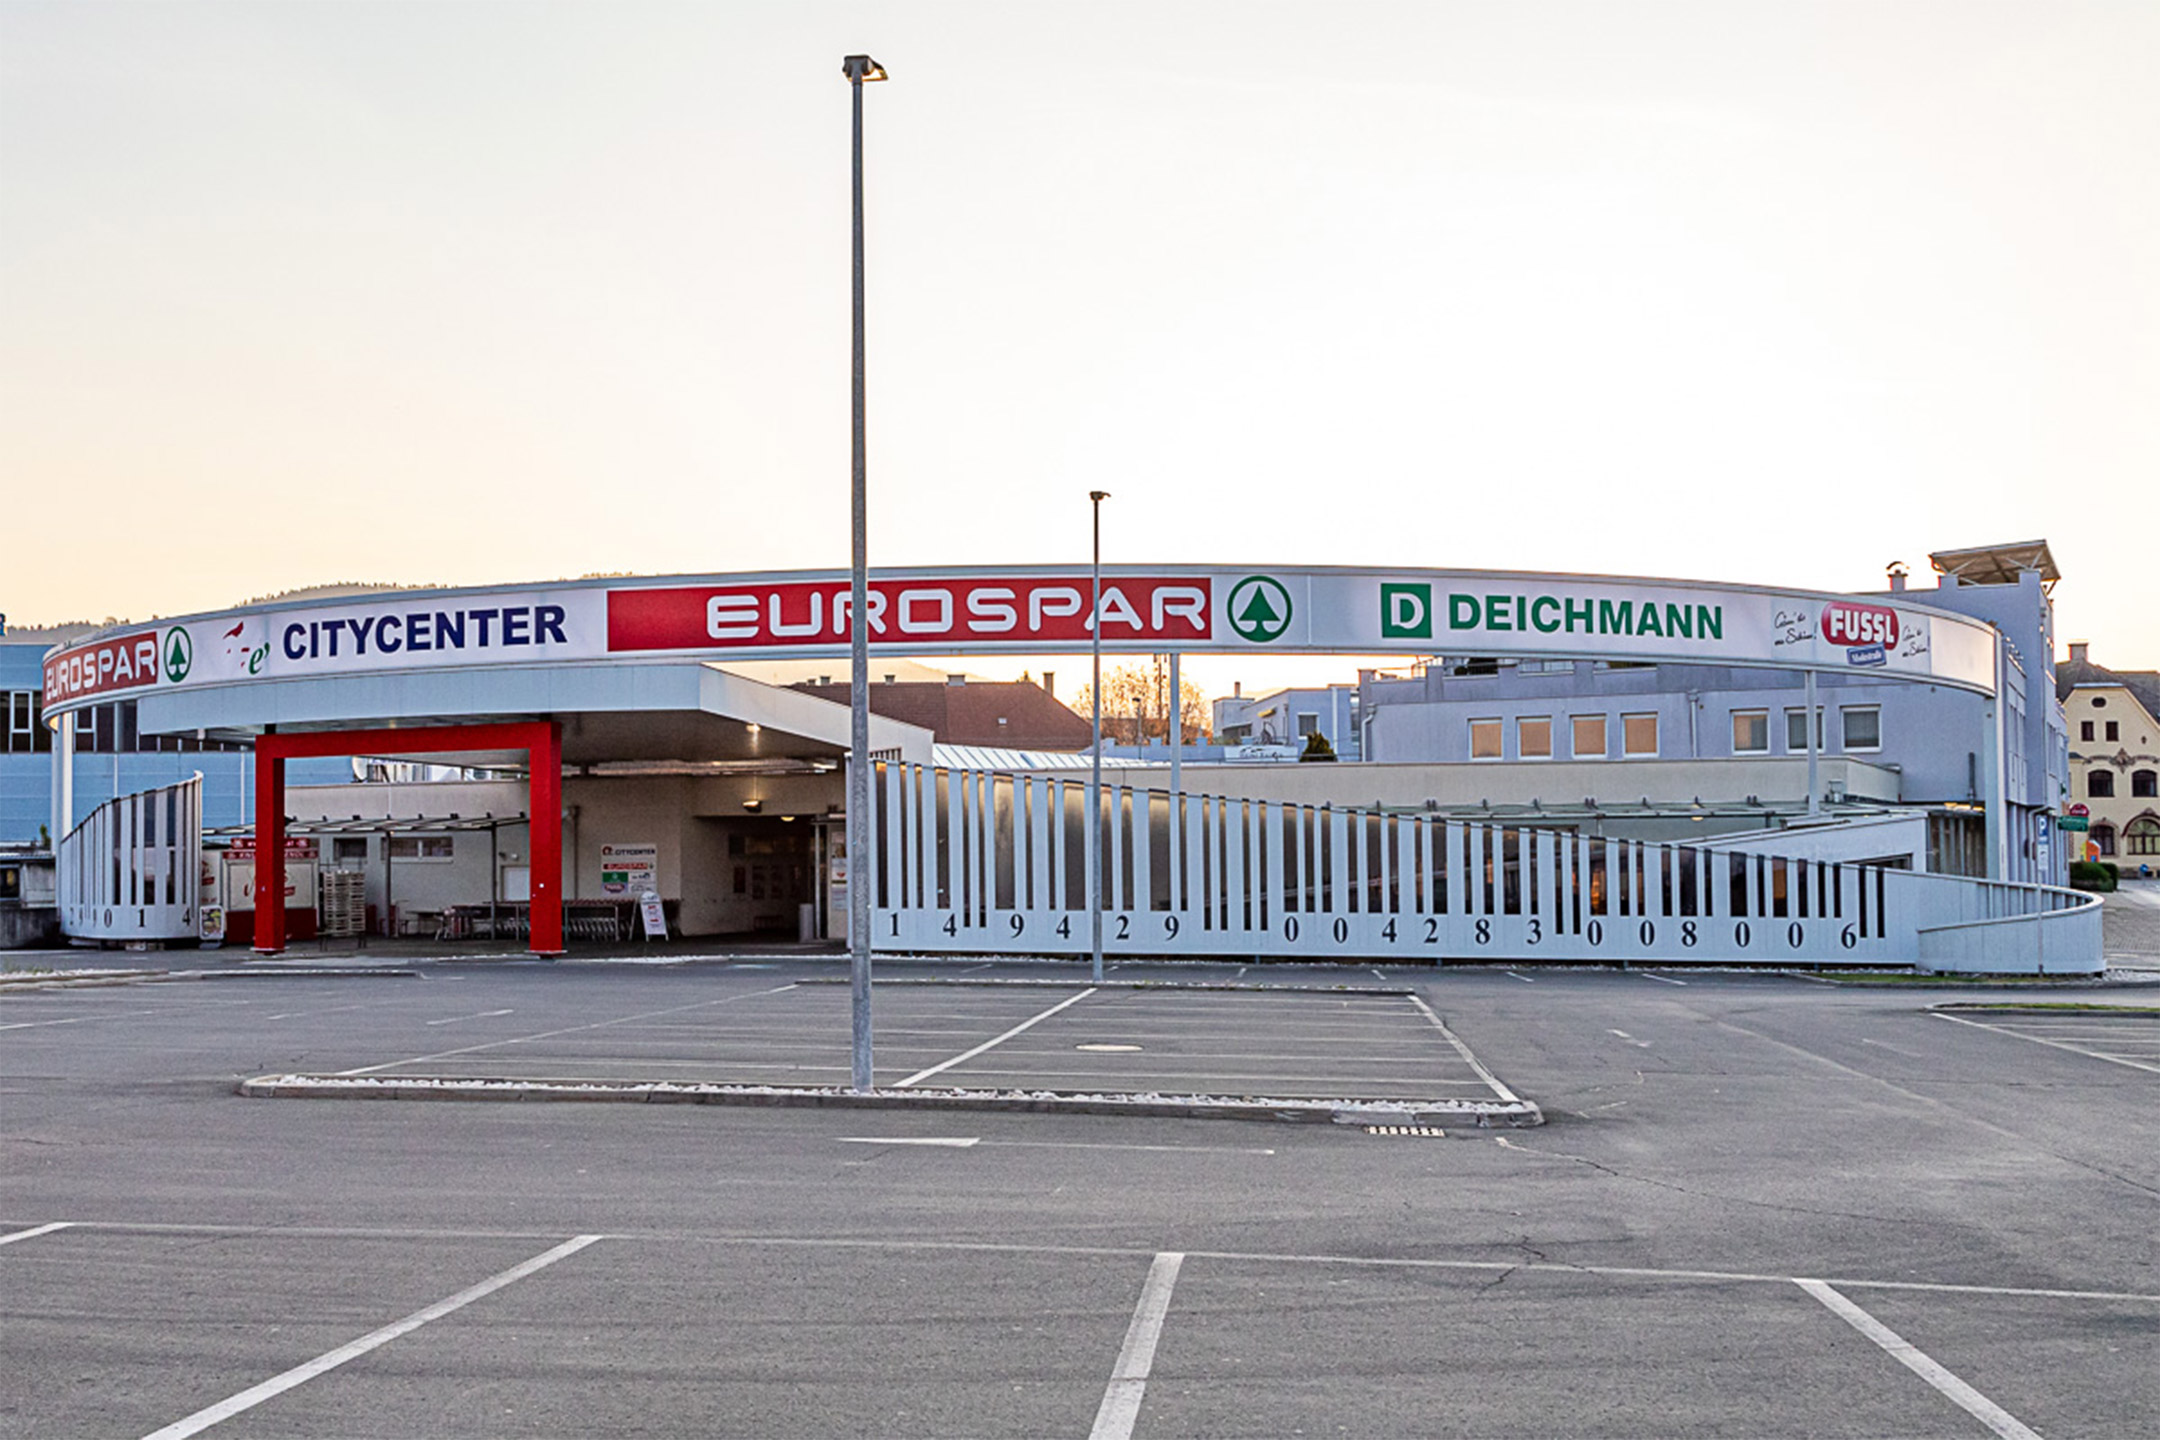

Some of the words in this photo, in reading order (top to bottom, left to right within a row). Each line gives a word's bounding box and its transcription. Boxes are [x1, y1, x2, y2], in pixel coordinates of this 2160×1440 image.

[283, 604, 568, 661] CITYCENTER
[707, 585, 1206, 639] EUROSPAR
[1391, 592, 1424, 630] D
[1450, 594, 1722, 639] DEICHMANN
[1830, 608, 1895, 643] FUSSL
[46, 640, 157, 701] EUROSPAR
[890, 913, 899, 937] 1
[943, 914, 957, 937] 4
[1010, 914, 1024, 939] 9
[1056, 915, 1070, 939] 4
[1116, 915, 1129, 940] 2
[1165, 916, 1179, 941] 9
[1284, 916, 1299, 942] 0
[1333, 918, 1348, 943] 0
[1382, 918, 1397, 943] 4
[1424, 918, 1438, 943] 2
[1476, 919, 1490, 944] 8
[1527, 919, 1541, 945] 3
[1588, 920, 1602, 946] 0
[1640, 920, 1655, 946] 0
[1682, 921, 1697, 947] 8
[1735, 922, 1750, 948] 0
[1788, 922, 1803, 948] 0
[1841, 923, 1857, 949] 6
